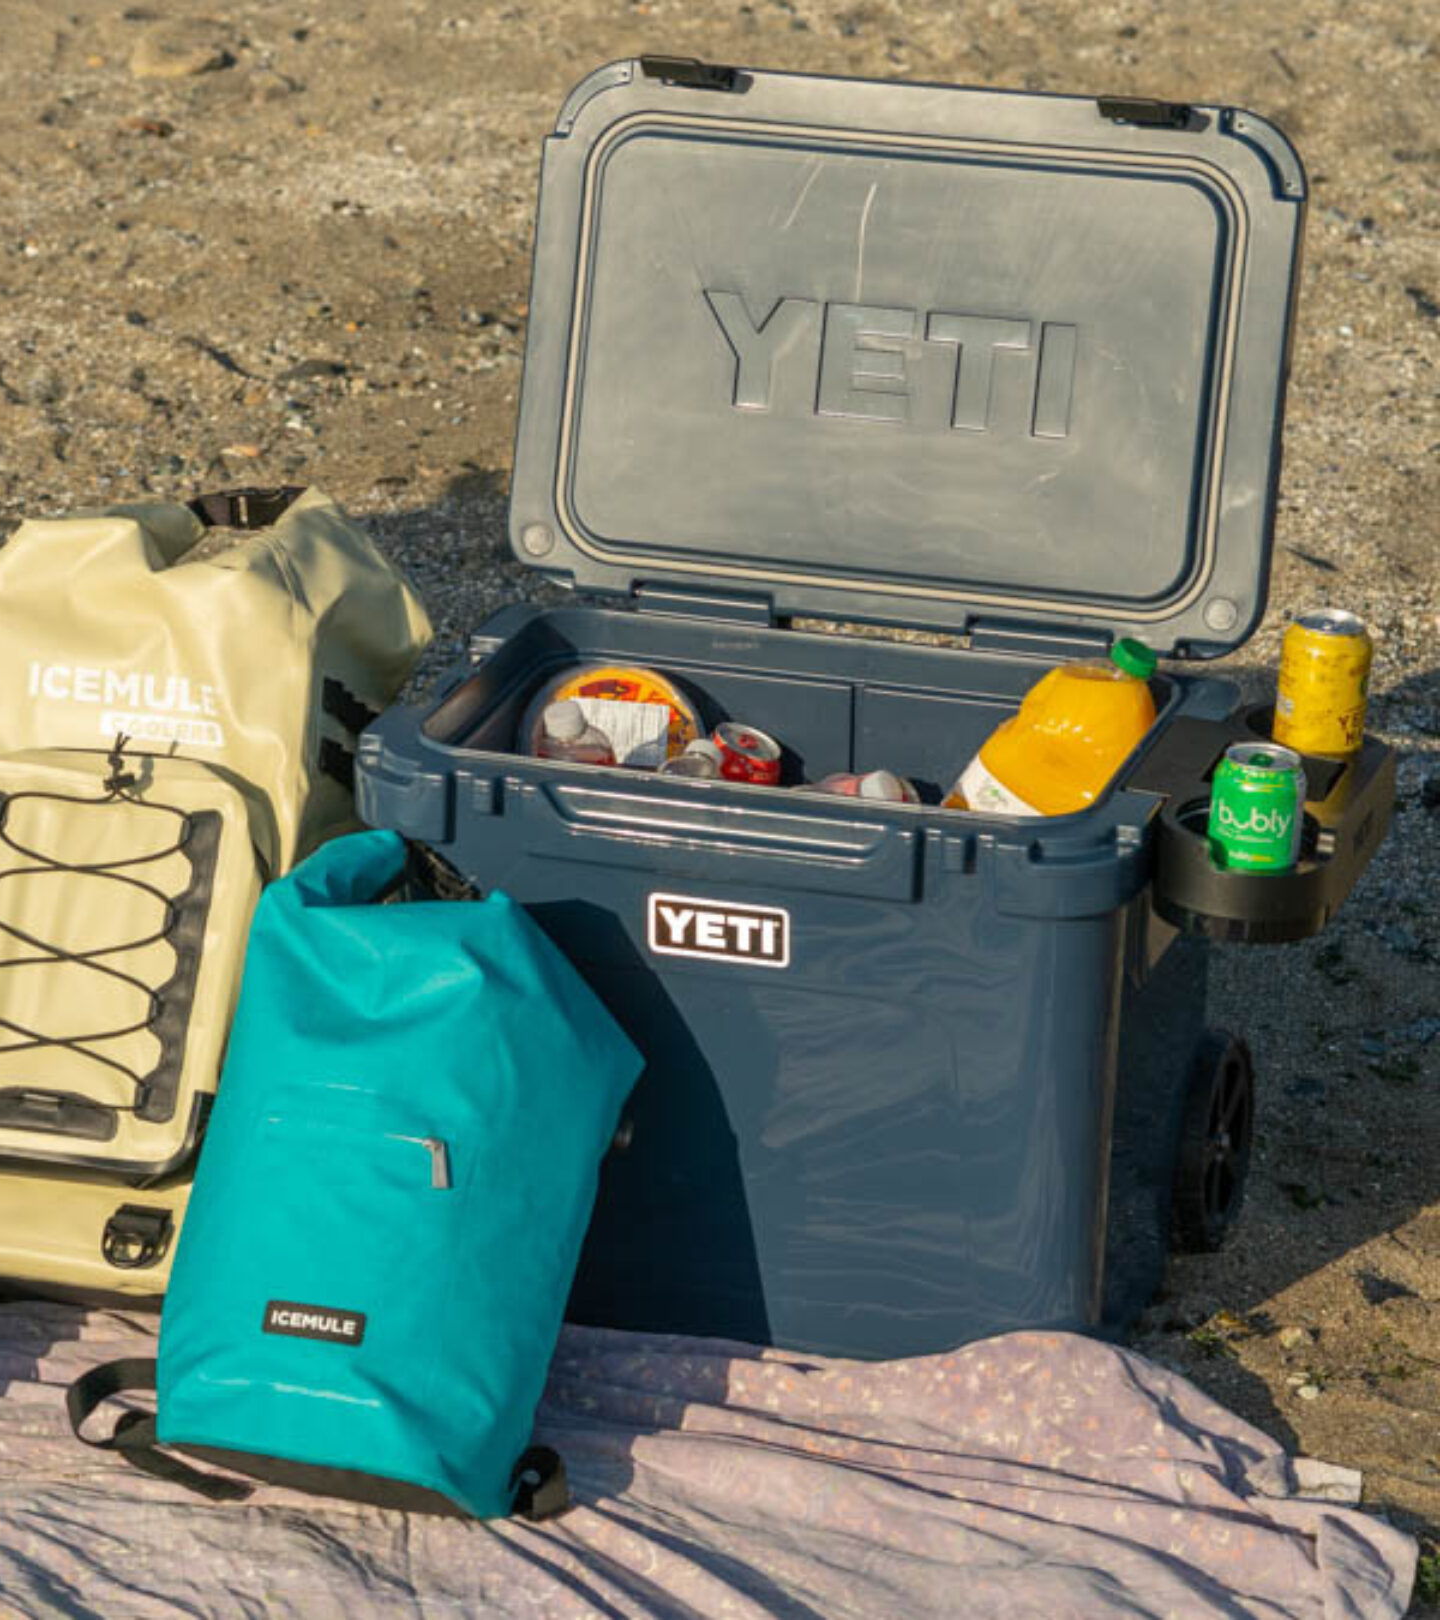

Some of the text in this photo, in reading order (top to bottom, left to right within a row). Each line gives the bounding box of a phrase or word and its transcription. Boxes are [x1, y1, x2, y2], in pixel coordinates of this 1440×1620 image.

[701, 285, 1079, 439] YETI
[28, 661, 219, 716] ICEMULE
[1218, 797, 1292, 839] bubly
[657, 905, 776, 955] YETI
[270, 1309, 357, 1336] ICEMULE
